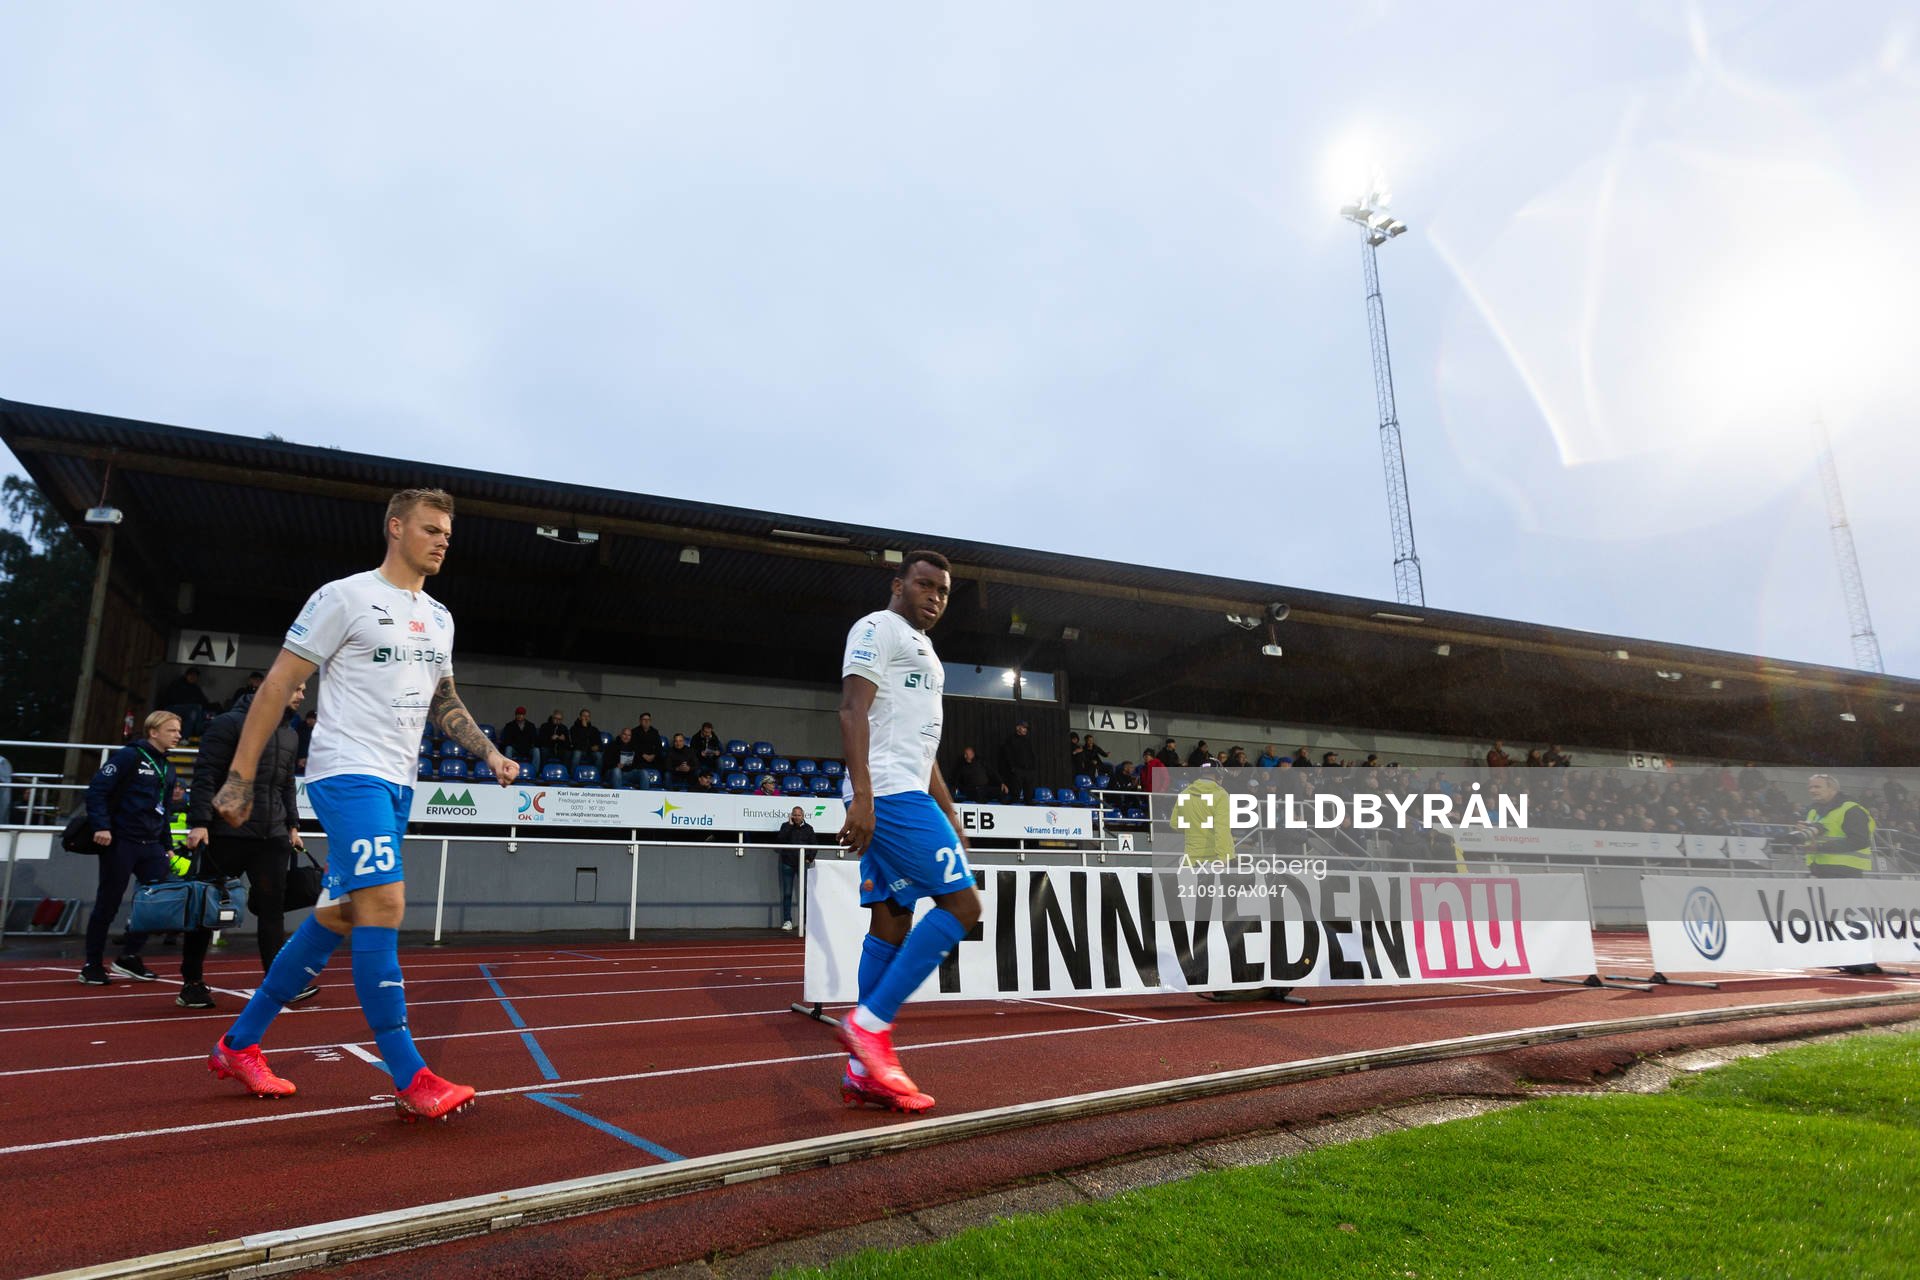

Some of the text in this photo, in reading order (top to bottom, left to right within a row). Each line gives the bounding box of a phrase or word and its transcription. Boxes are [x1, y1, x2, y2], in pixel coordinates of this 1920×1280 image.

[408, 620, 426, 633] 3M
[188, 635, 216, 662] A
[1100, 710, 1138, 730] A B
[426, 806, 477, 816] ERIWOOD
[743, 807, 813, 820] Finnvedsboer
[671, 813, 713, 826] bravida
[963, 811, 995, 830] EB
[1024, 825, 1082, 836] Värnamo Energi AB
[1122, 839, 1131, 851] A
[350, 835, 396, 876] 25
[935, 841, 972, 884] 21
[1419, 881, 1522, 971] nu
